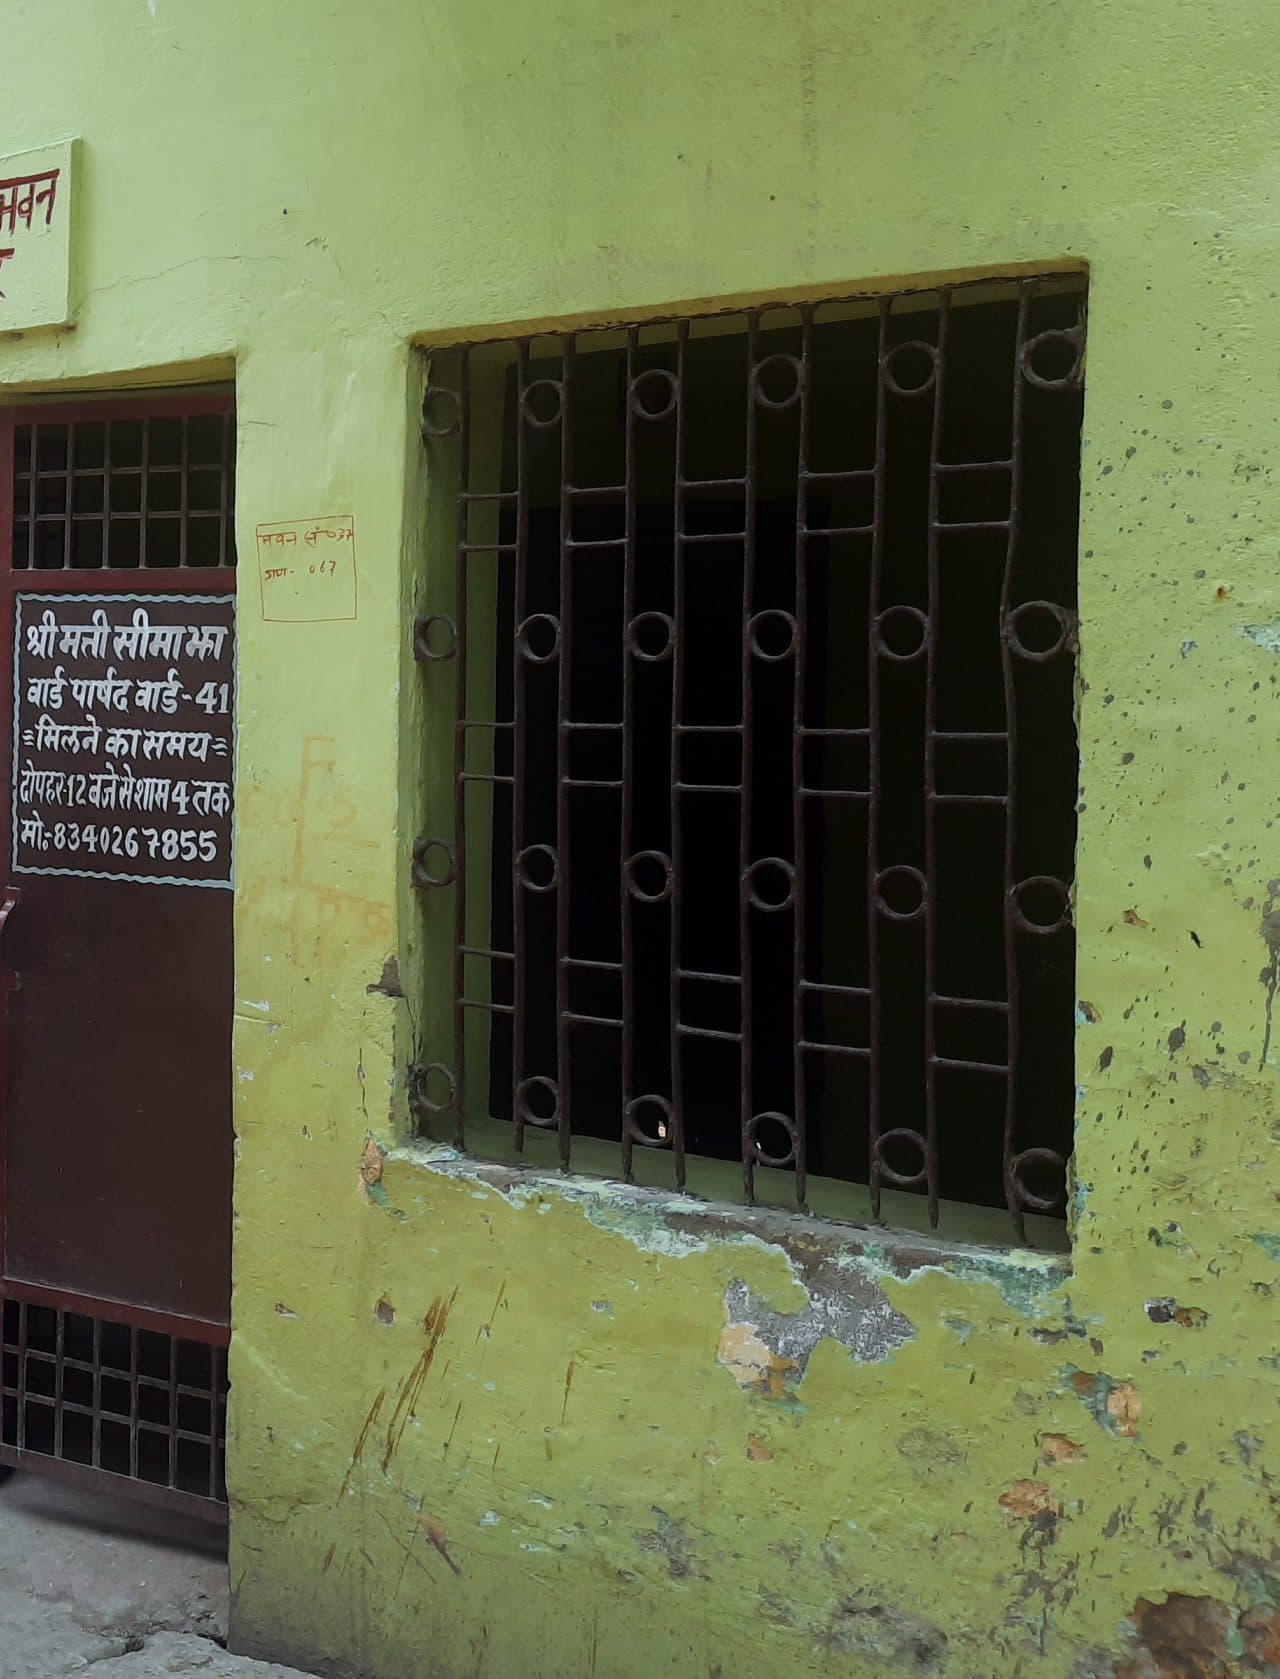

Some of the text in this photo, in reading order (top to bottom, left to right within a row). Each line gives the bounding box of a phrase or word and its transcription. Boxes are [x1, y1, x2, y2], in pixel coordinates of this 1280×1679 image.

[112, 607, 186, 661] सीमा
[185, 625, 229, 661] झा
[27, 665, 68, 709] वार्ड
[69, 666, 134, 713] पार्षद
[104, 725, 142, 760] का
[88, 761, 119, 811] बजे
[119, 762, 138, 808] से
[172, 780, 190, 816] 4
[191, 780, 231, 818] तक
